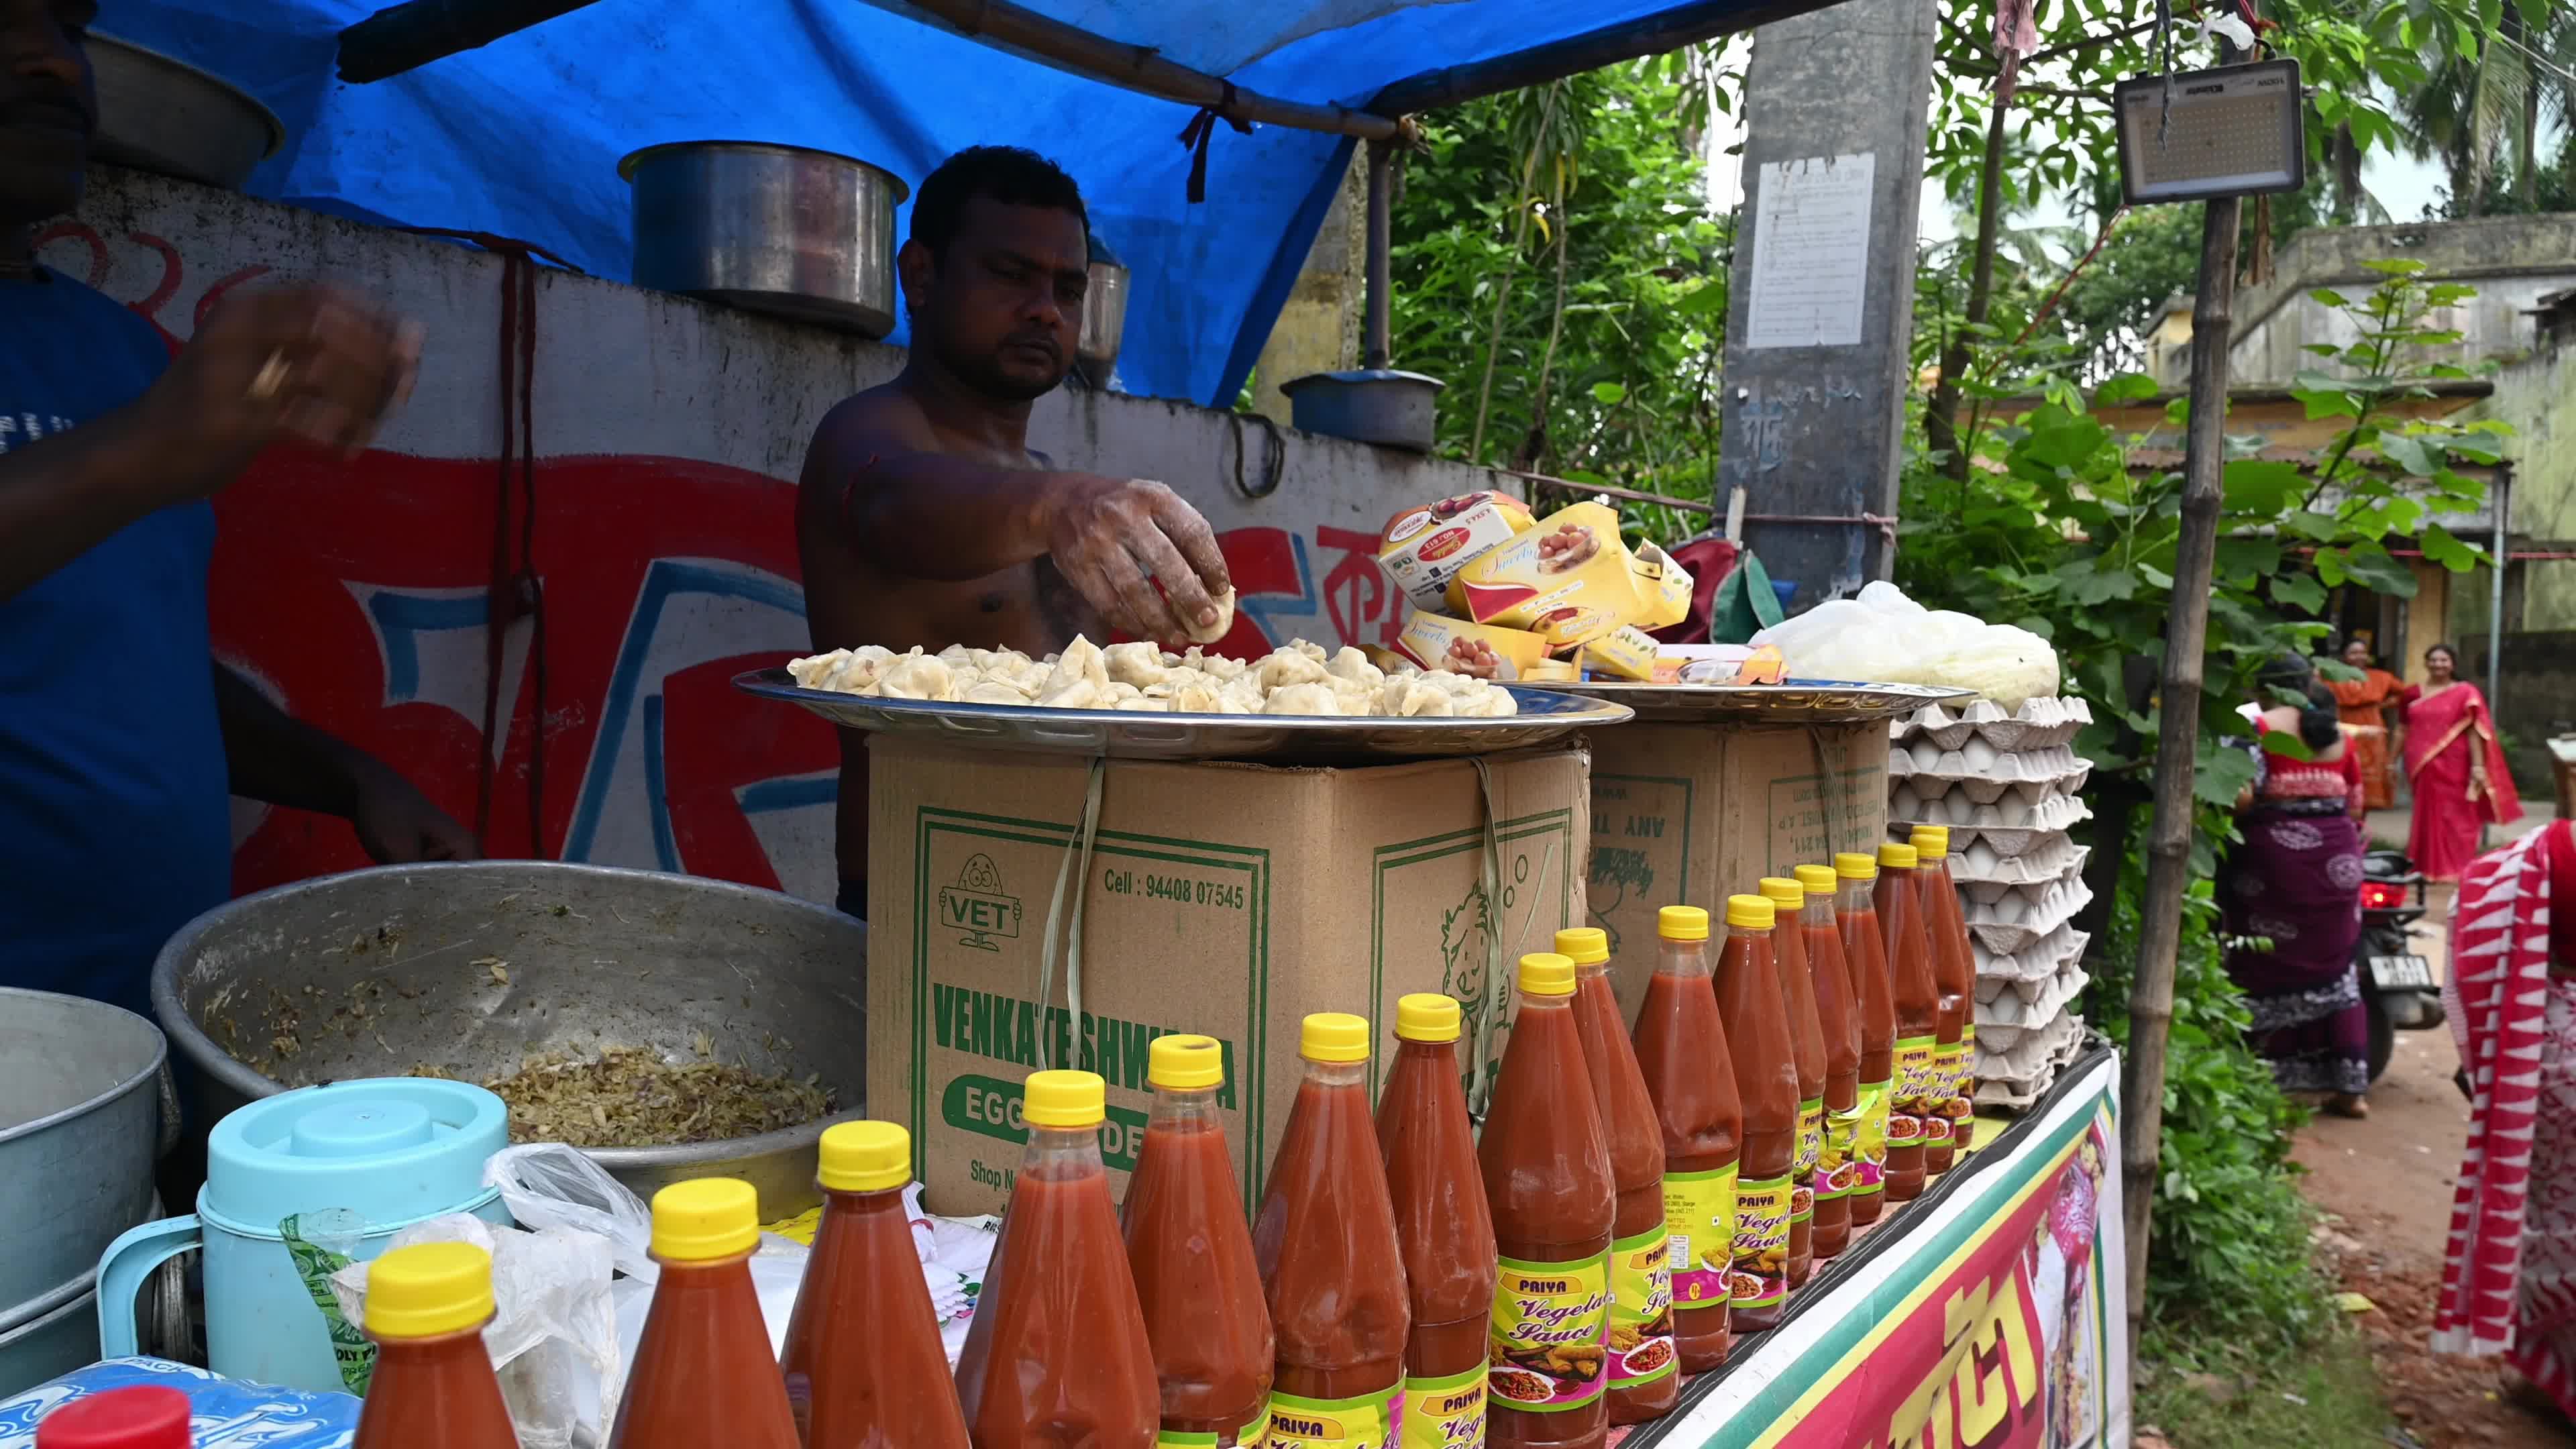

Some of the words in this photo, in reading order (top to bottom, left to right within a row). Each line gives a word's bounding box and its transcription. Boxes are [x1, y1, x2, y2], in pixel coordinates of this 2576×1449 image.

[1624, 816, 1666, 838] ANY
[1105, 869, 1132, 894] Cell
[1146, 874, 1191, 902] 94408
[1196, 881, 1244, 910] 07545
[949, 896, 1010, 930] VET
[1902, 1051, 1927, 1062] PRIYA
[971, 1159, 1002, 1192] Shop
[1738, 1195, 1774, 1207] PRIYA
[1519, 1279, 1566, 1293] PRIYA
[1509, 1323, 1594, 1342] Sauce
[333, 1346, 358, 1362] OLY
[1443, 1387, 1481, 1412] PRIYA
[1271, 1413, 1324, 1437] PRIYA
